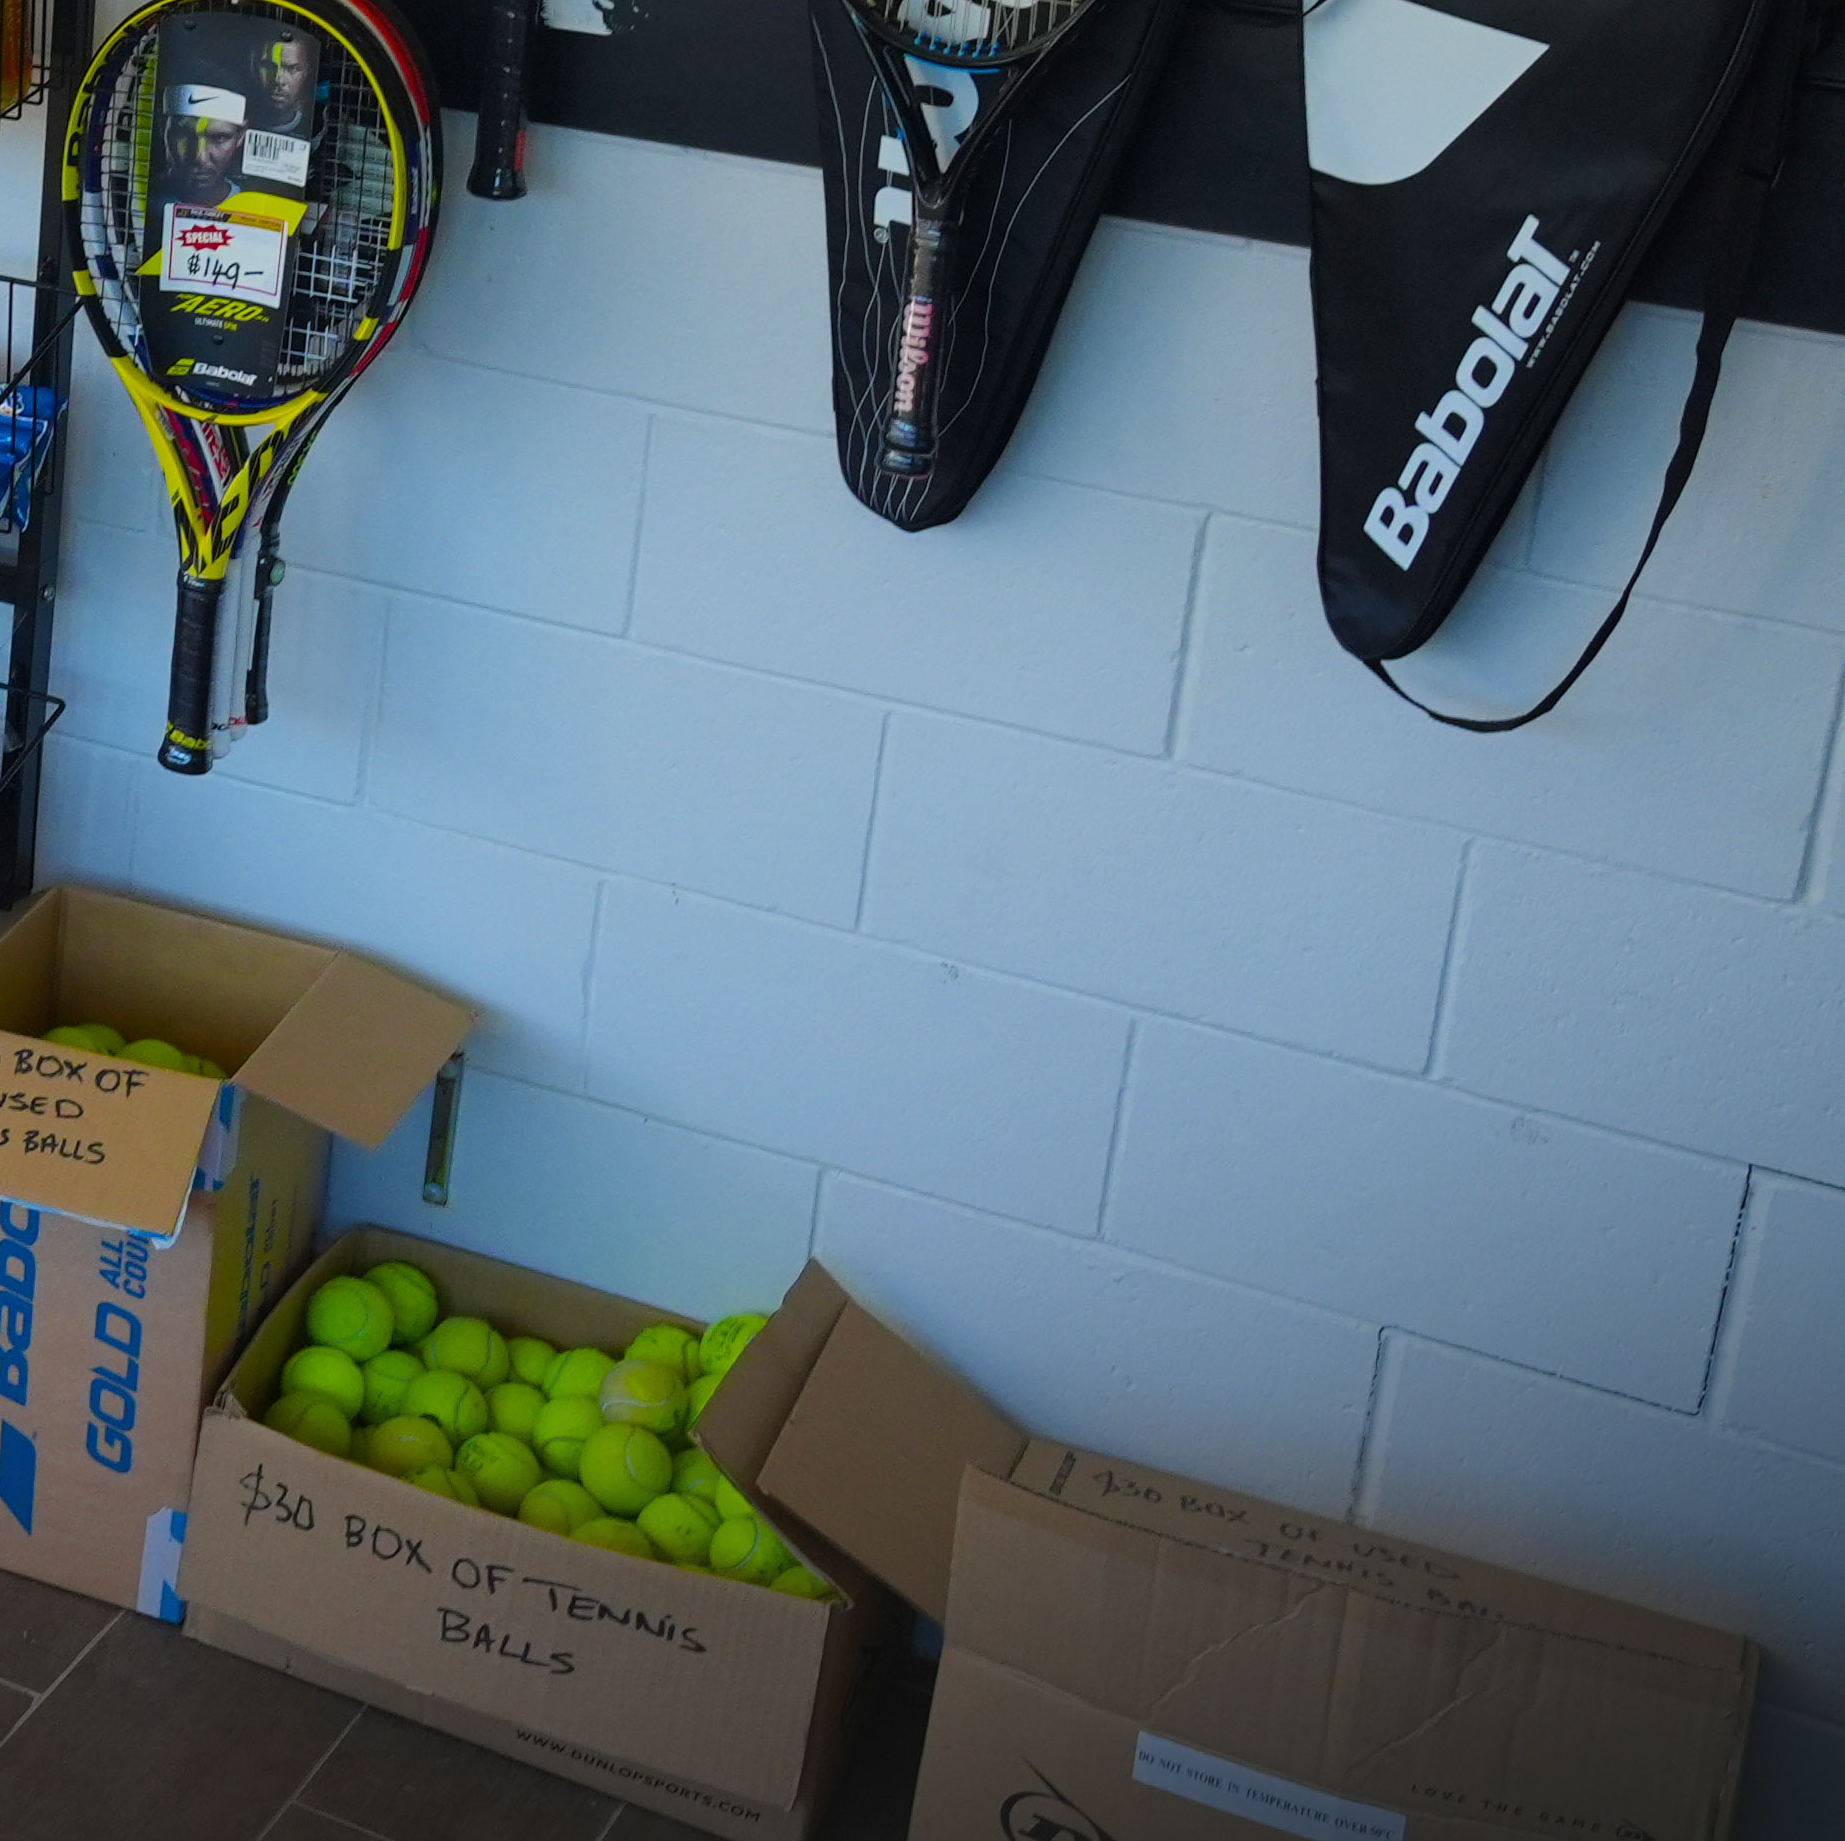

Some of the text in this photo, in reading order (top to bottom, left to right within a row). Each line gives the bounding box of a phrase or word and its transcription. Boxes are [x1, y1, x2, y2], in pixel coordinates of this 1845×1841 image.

[183, 228, 225, 247] SPECIAL
[171, 294, 257, 323] AERO
[193, 361, 258, 387] Babolat
[1362, 212, 1575, 573] Babolat
[13, 1046, 87, 1086] BOX
[94, 1063, 151, 1100] OF
[22, 1129, 108, 1167] BALLS
[98, 1239, 125, 1290] ALL
[86, 1301, 143, 1474] GOLD
[238, 1463, 711, 1655] $30 BOX OF TENNIS
[1179, 1491, 1252, 1527] BOX
[1278, 1519, 1326, 1545] OF
[1351, 1539, 1462, 1582] USED
[436, 1605, 577, 1677] BALLS
[515, 1728, 761, 1823] WWW.DUNLOPSPORTS.COM
[1137, 1748, 1156, 1766] DO
[1159, 1754, 1183, 1777] NOT
[1185, 1762, 1224, 1790] STORE
[1227, 1777, 1240, 1794] IN
[1244, 1784, 1331, 1825] TEMPERATURE
[1334, 1813, 1368, 1837] OVER
[1410, 1781, 1469, 1802] LOVE
[1479, 1798, 1528, 1818] THE
